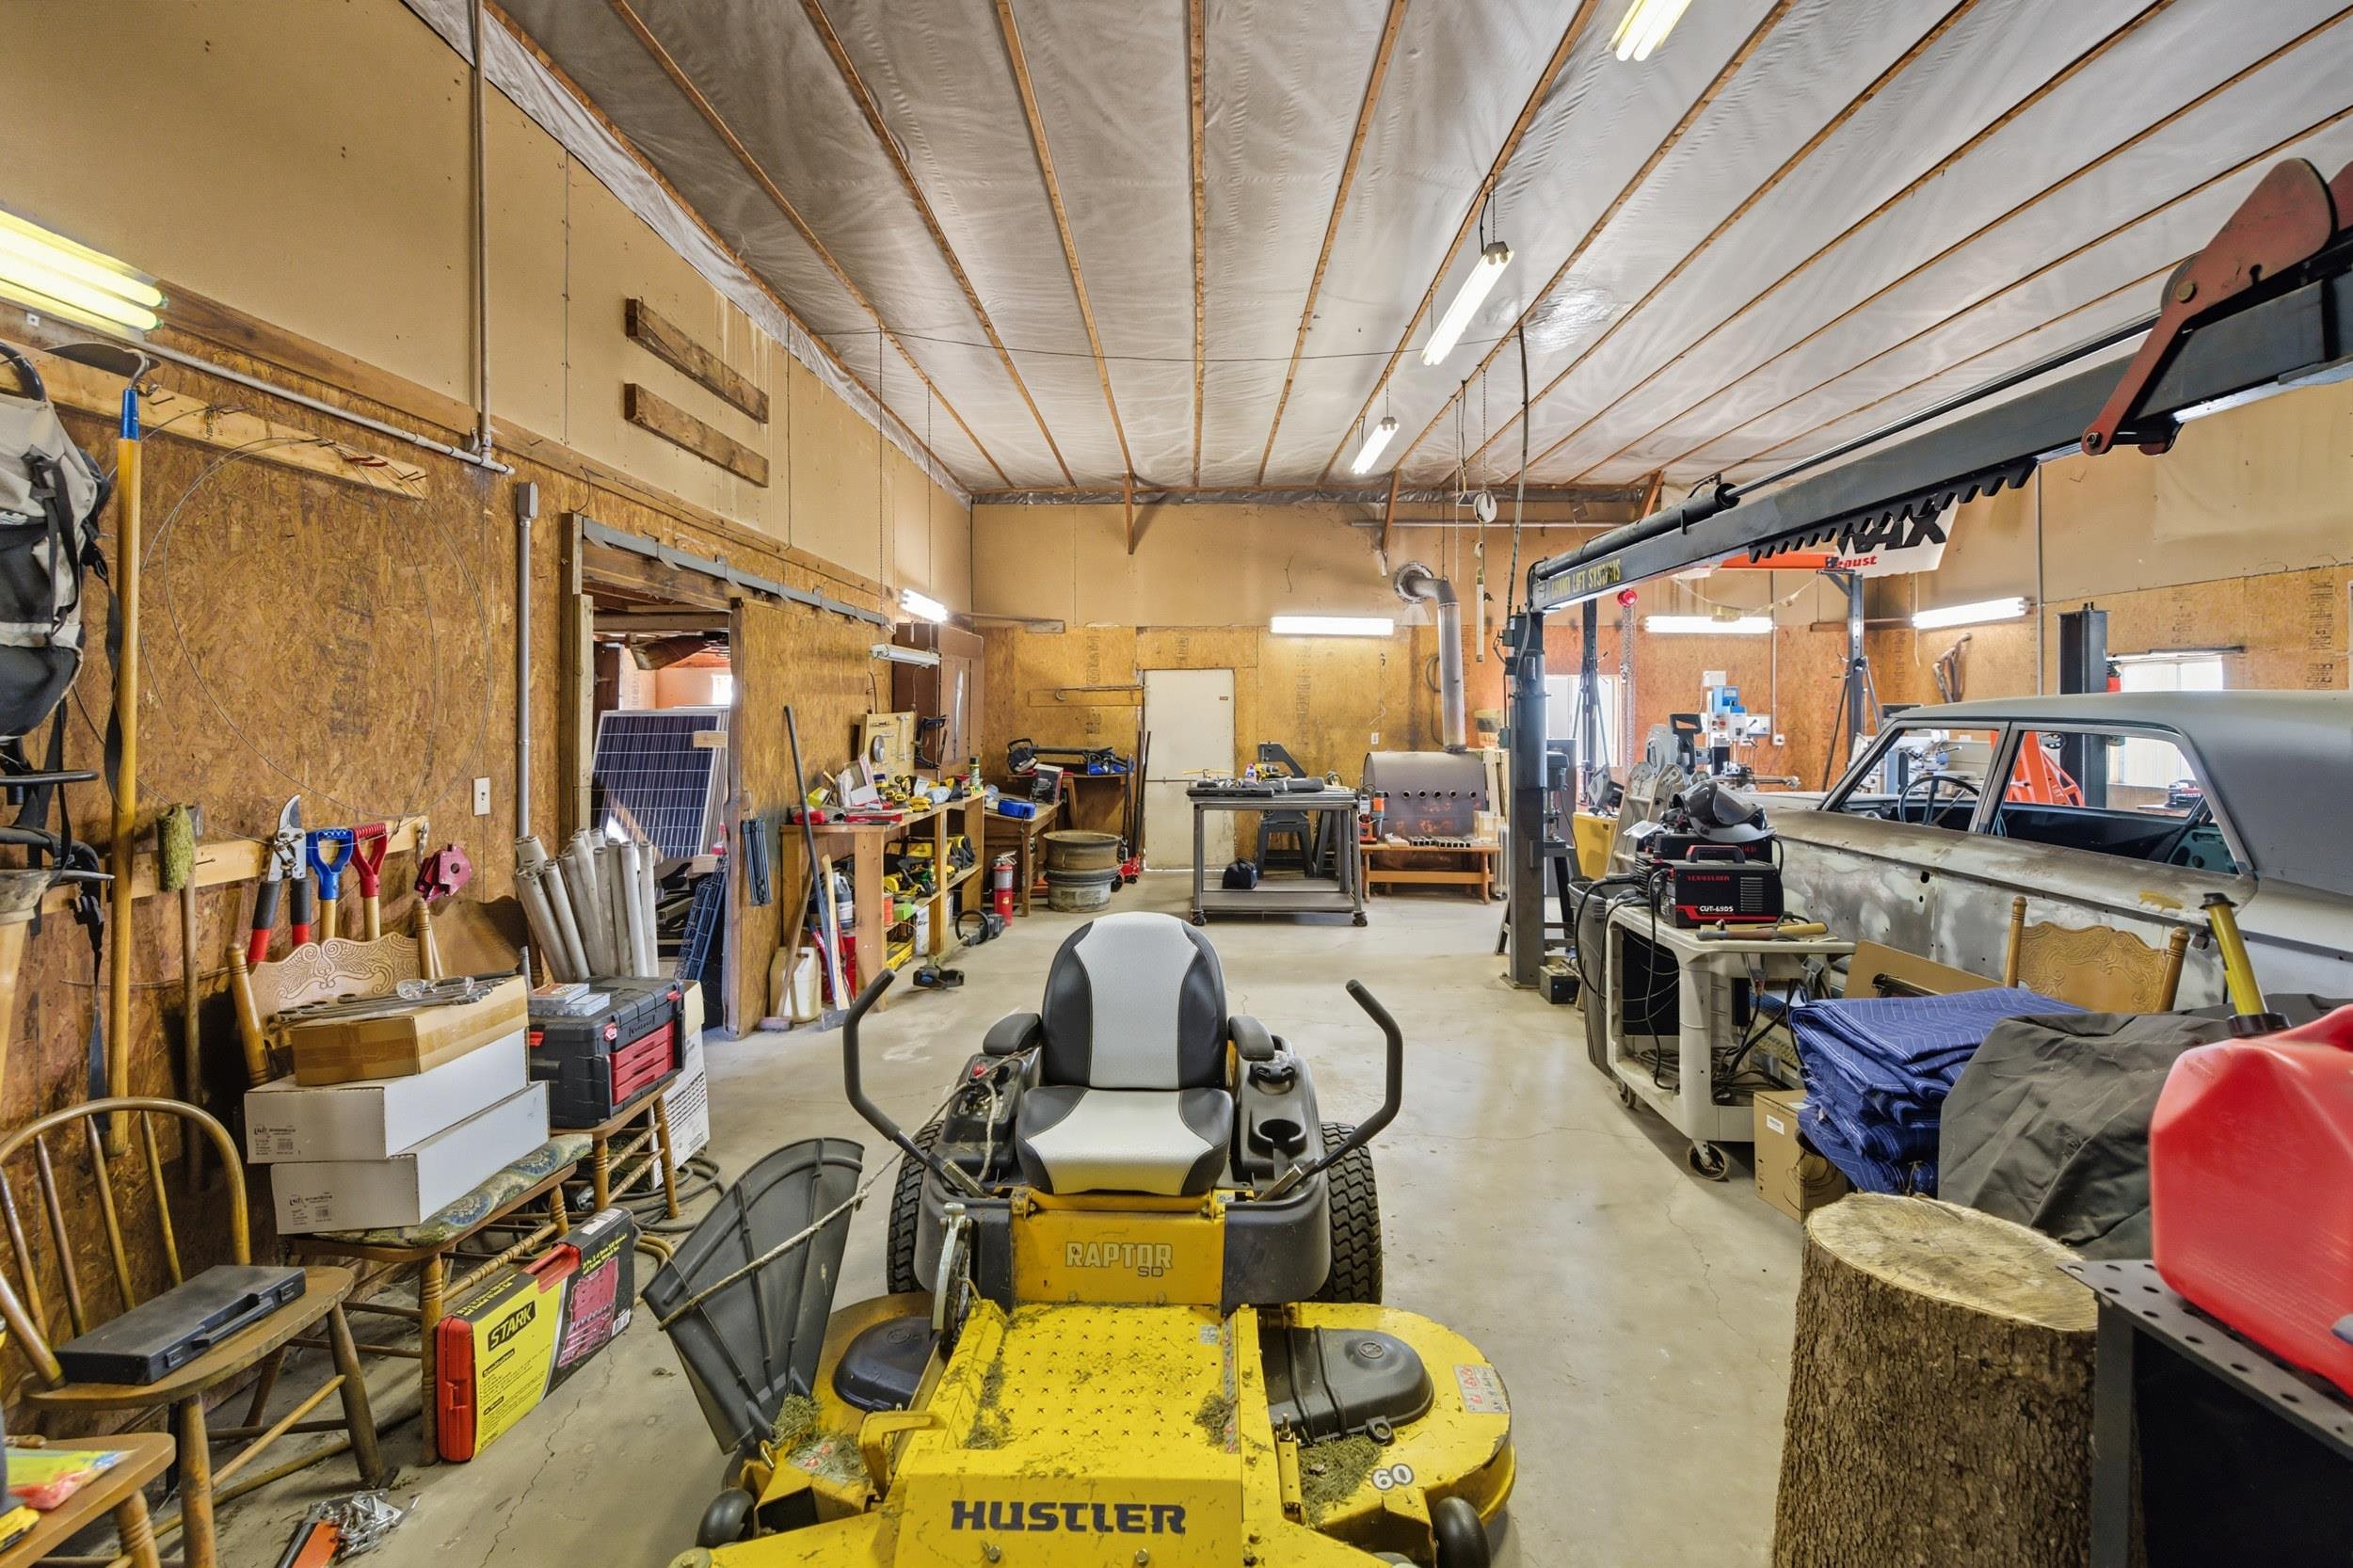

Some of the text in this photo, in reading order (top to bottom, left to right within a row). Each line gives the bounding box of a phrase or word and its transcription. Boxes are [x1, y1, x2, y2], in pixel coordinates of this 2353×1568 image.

[1065, 1241, 1173, 1269] RAPTOR
[1137, 1266, 1163, 1277] SD
[489, 1304, 533, 1348] STARK
[1371, 1464, 1414, 1491] 60
[951, 1500, 1186, 1535] HUSTLER
